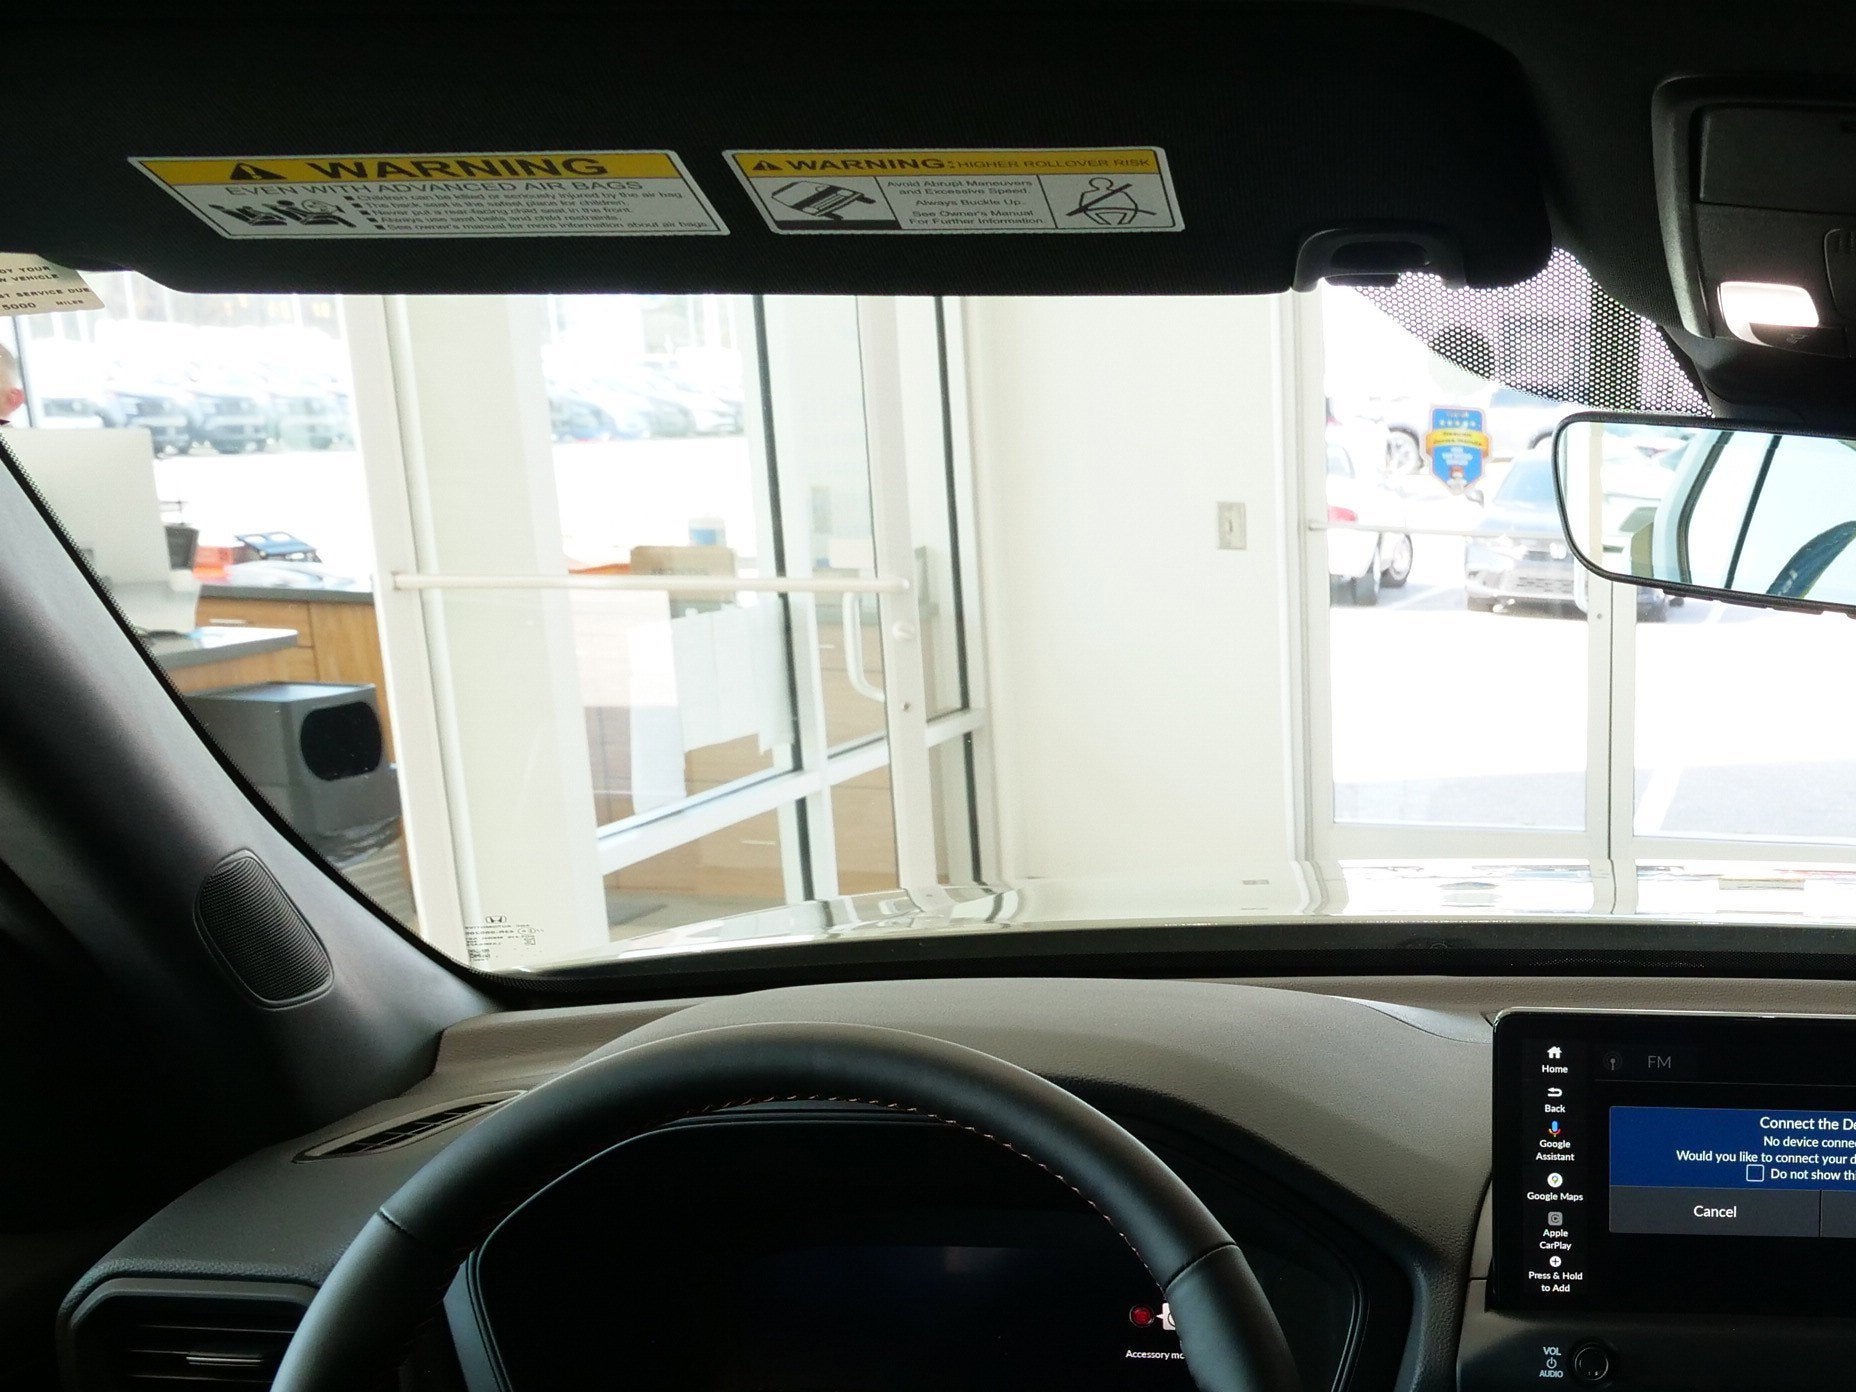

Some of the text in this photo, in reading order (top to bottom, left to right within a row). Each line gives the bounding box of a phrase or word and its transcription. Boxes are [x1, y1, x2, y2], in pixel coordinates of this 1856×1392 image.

[307, 158, 607, 178] WARNING
[786, 159, 955, 171] WARNING:
[1024, 159, 1110, 168] ROLLOVER
[1114, 158, 1151, 167] RISK
[226, 181, 643, 196] EVEN WITH ADVANCED AIR BAGS
[1648, 1055, 1671, 1068] FM
[1542, 1064, 1568, 1073] Home
[1544, 1104, 1566, 1113] Back
[1760, 1117, 1815, 1129] Connect
[1818, 1117, 1839, 1130] the
[1539, 1139, 1571, 1149] Google
[1764, 1136, 1780, 1146] No
[1782, 1136, 1819, 1147] device
[1536, 1152, 1575, 1161] Assistant
[1676, 1150, 1712, 1161] Would
[1715, 1153, 1736, 1163] you
[1739, 1151, 1759, 1162] like
[1761, 1152, 1772, 1162] to
[1775, 1154, 1819, 1163] connect
[1821, 1156, 1848, 1166] your
[1770, 1168, 1787, 1179] Do
[1790, 1170, 1809, 1179] not
[1811, 1169, 1841, 1180] show
[1527, 1192, 1583, 1202] Google Maps
[1693, 1205, 1736, 1217] Cancel
[1542, 1229, 1568, 1238] Apple
[1539, 1241, 1572, 1251] CarPlay
[1528, 1271, 1583, 1280] Press & Hold
[1552, 1284, 1570, 1292] Add
[1125, 1350, 1170, 1360] Accessory
[1542, 1346, 1562, 1356] VOL
[1539, 1370, 1564, 1378] AUDIO
